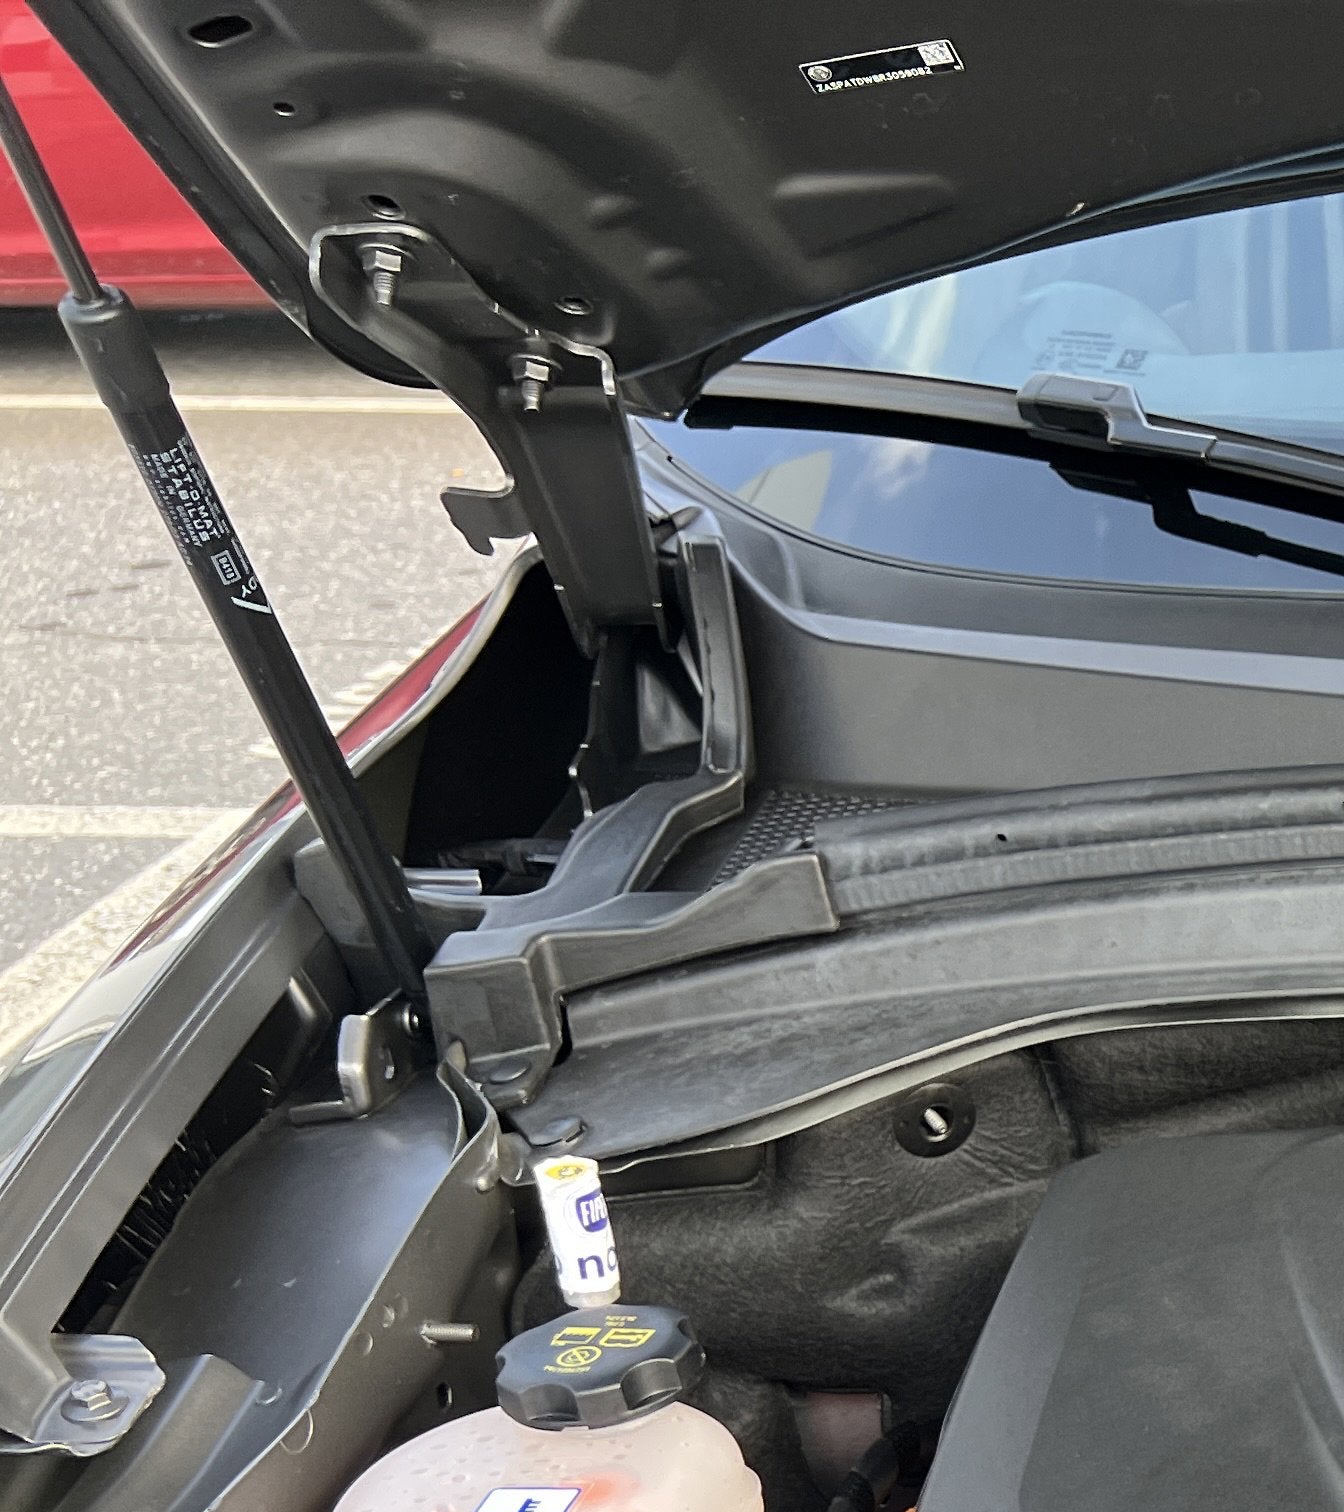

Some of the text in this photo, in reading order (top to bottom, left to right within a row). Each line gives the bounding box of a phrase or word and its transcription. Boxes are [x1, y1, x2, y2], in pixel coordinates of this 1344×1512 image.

[160, 452, 210, 541] STABILUS
[176, 505, 202, 547] GERMANY
[580, 1193, 608, 1227] FIA
